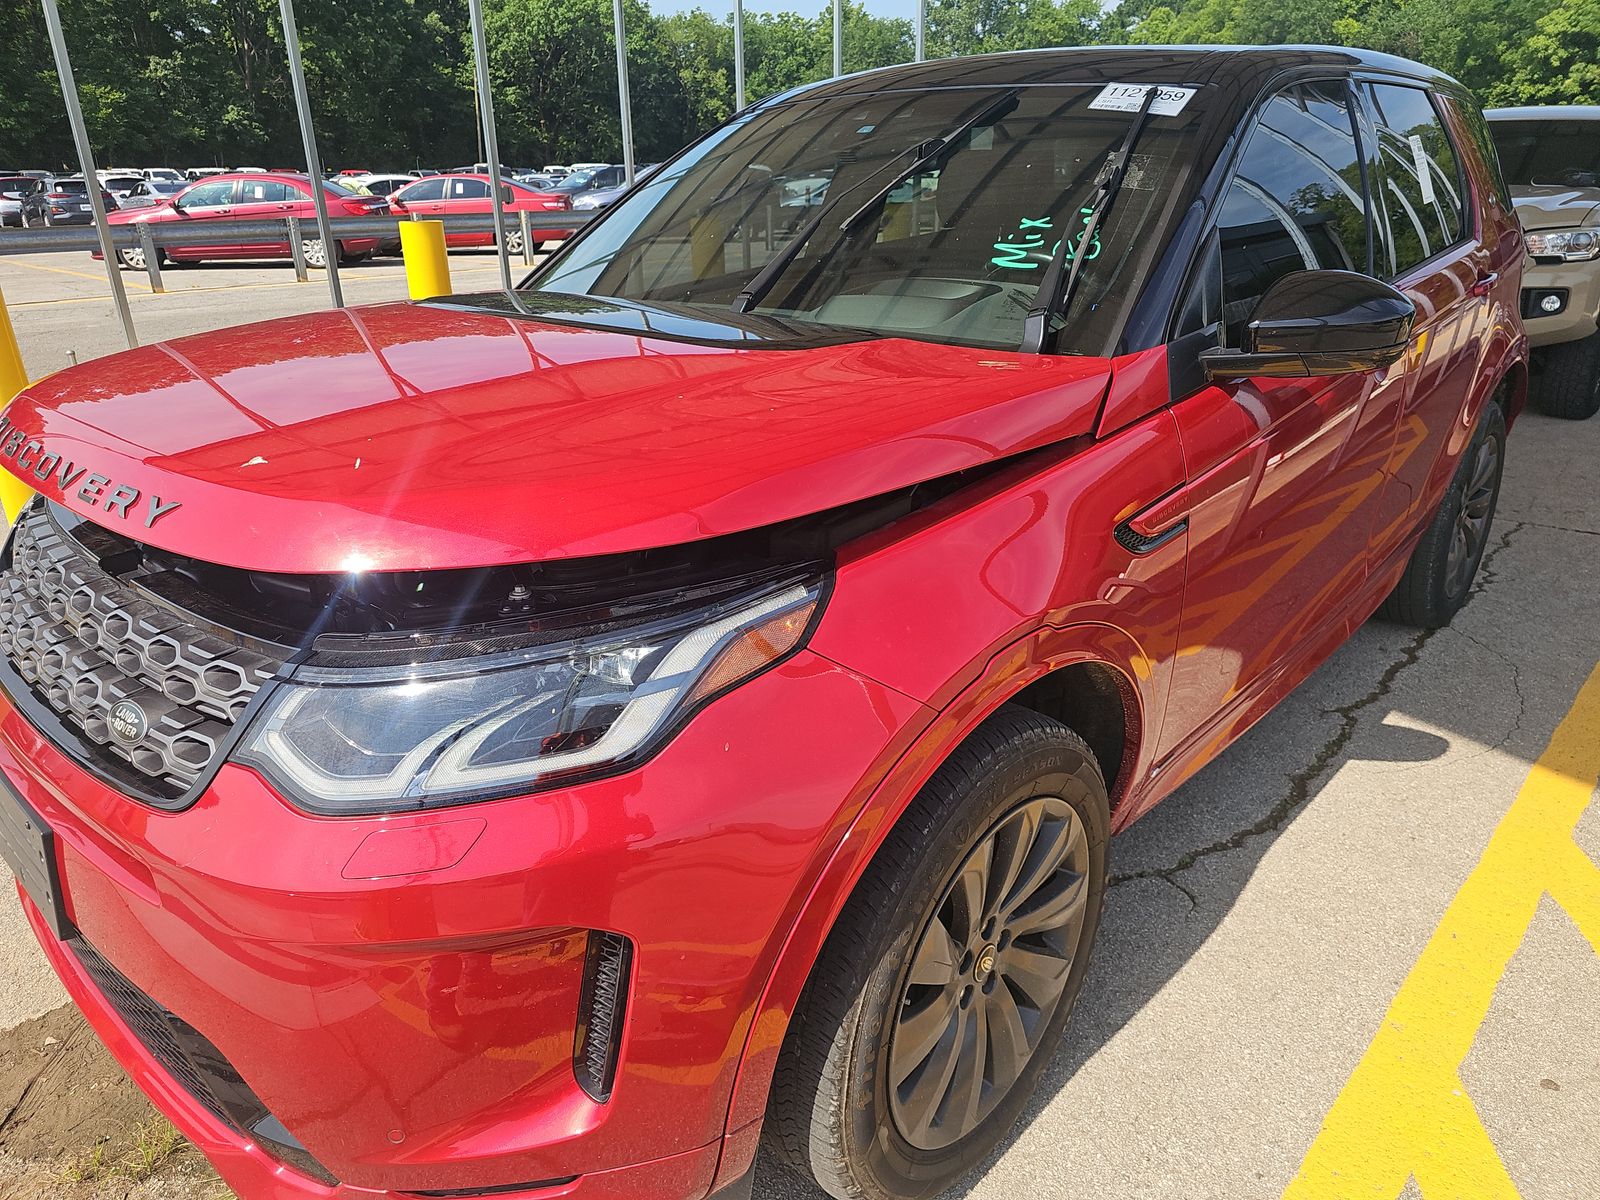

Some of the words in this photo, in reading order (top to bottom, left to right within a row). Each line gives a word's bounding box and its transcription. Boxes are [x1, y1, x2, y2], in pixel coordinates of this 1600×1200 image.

[991, 216, 1053, 269] Mix
[115, 705, 136, 724] LAND
[113, 717, 138, 739] ROVER
